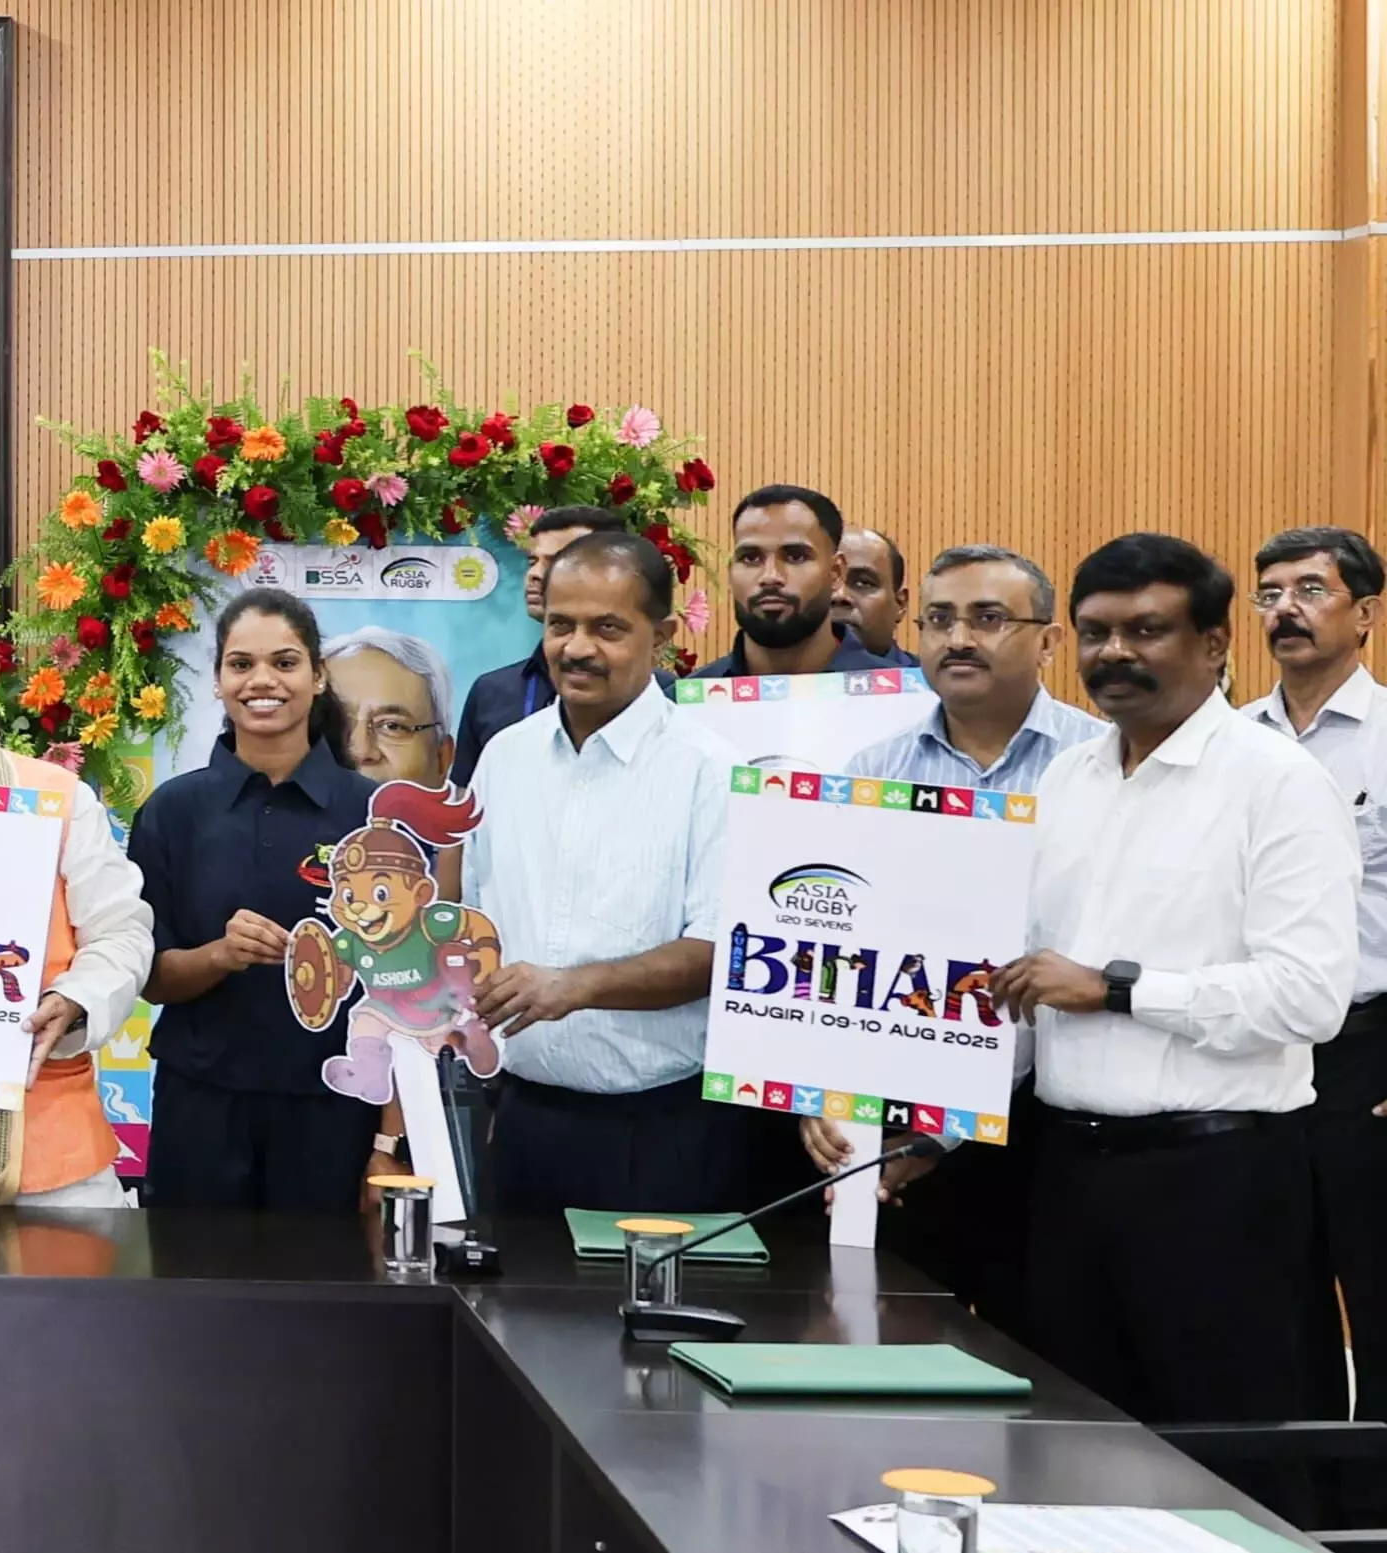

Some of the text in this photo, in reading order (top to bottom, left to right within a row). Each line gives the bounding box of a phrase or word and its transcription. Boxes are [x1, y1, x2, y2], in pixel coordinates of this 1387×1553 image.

[306, 571, 363, 584] BSSA
[395, 570, 426, 579] ASIA
[390, 579, 431, 589] RUGBY
[793, 882, 848, 900] ASIA
[785, 895, 858, 917] RUGBY
[776, 914, 853, 932] U20 SEVENS
[372, 968, 423, 985] ASHOKA
[725, 922, 1003, 1028] BIHAR
[726, 1000, 999, 1050] RAJGIR 09-10 AUG 2025
